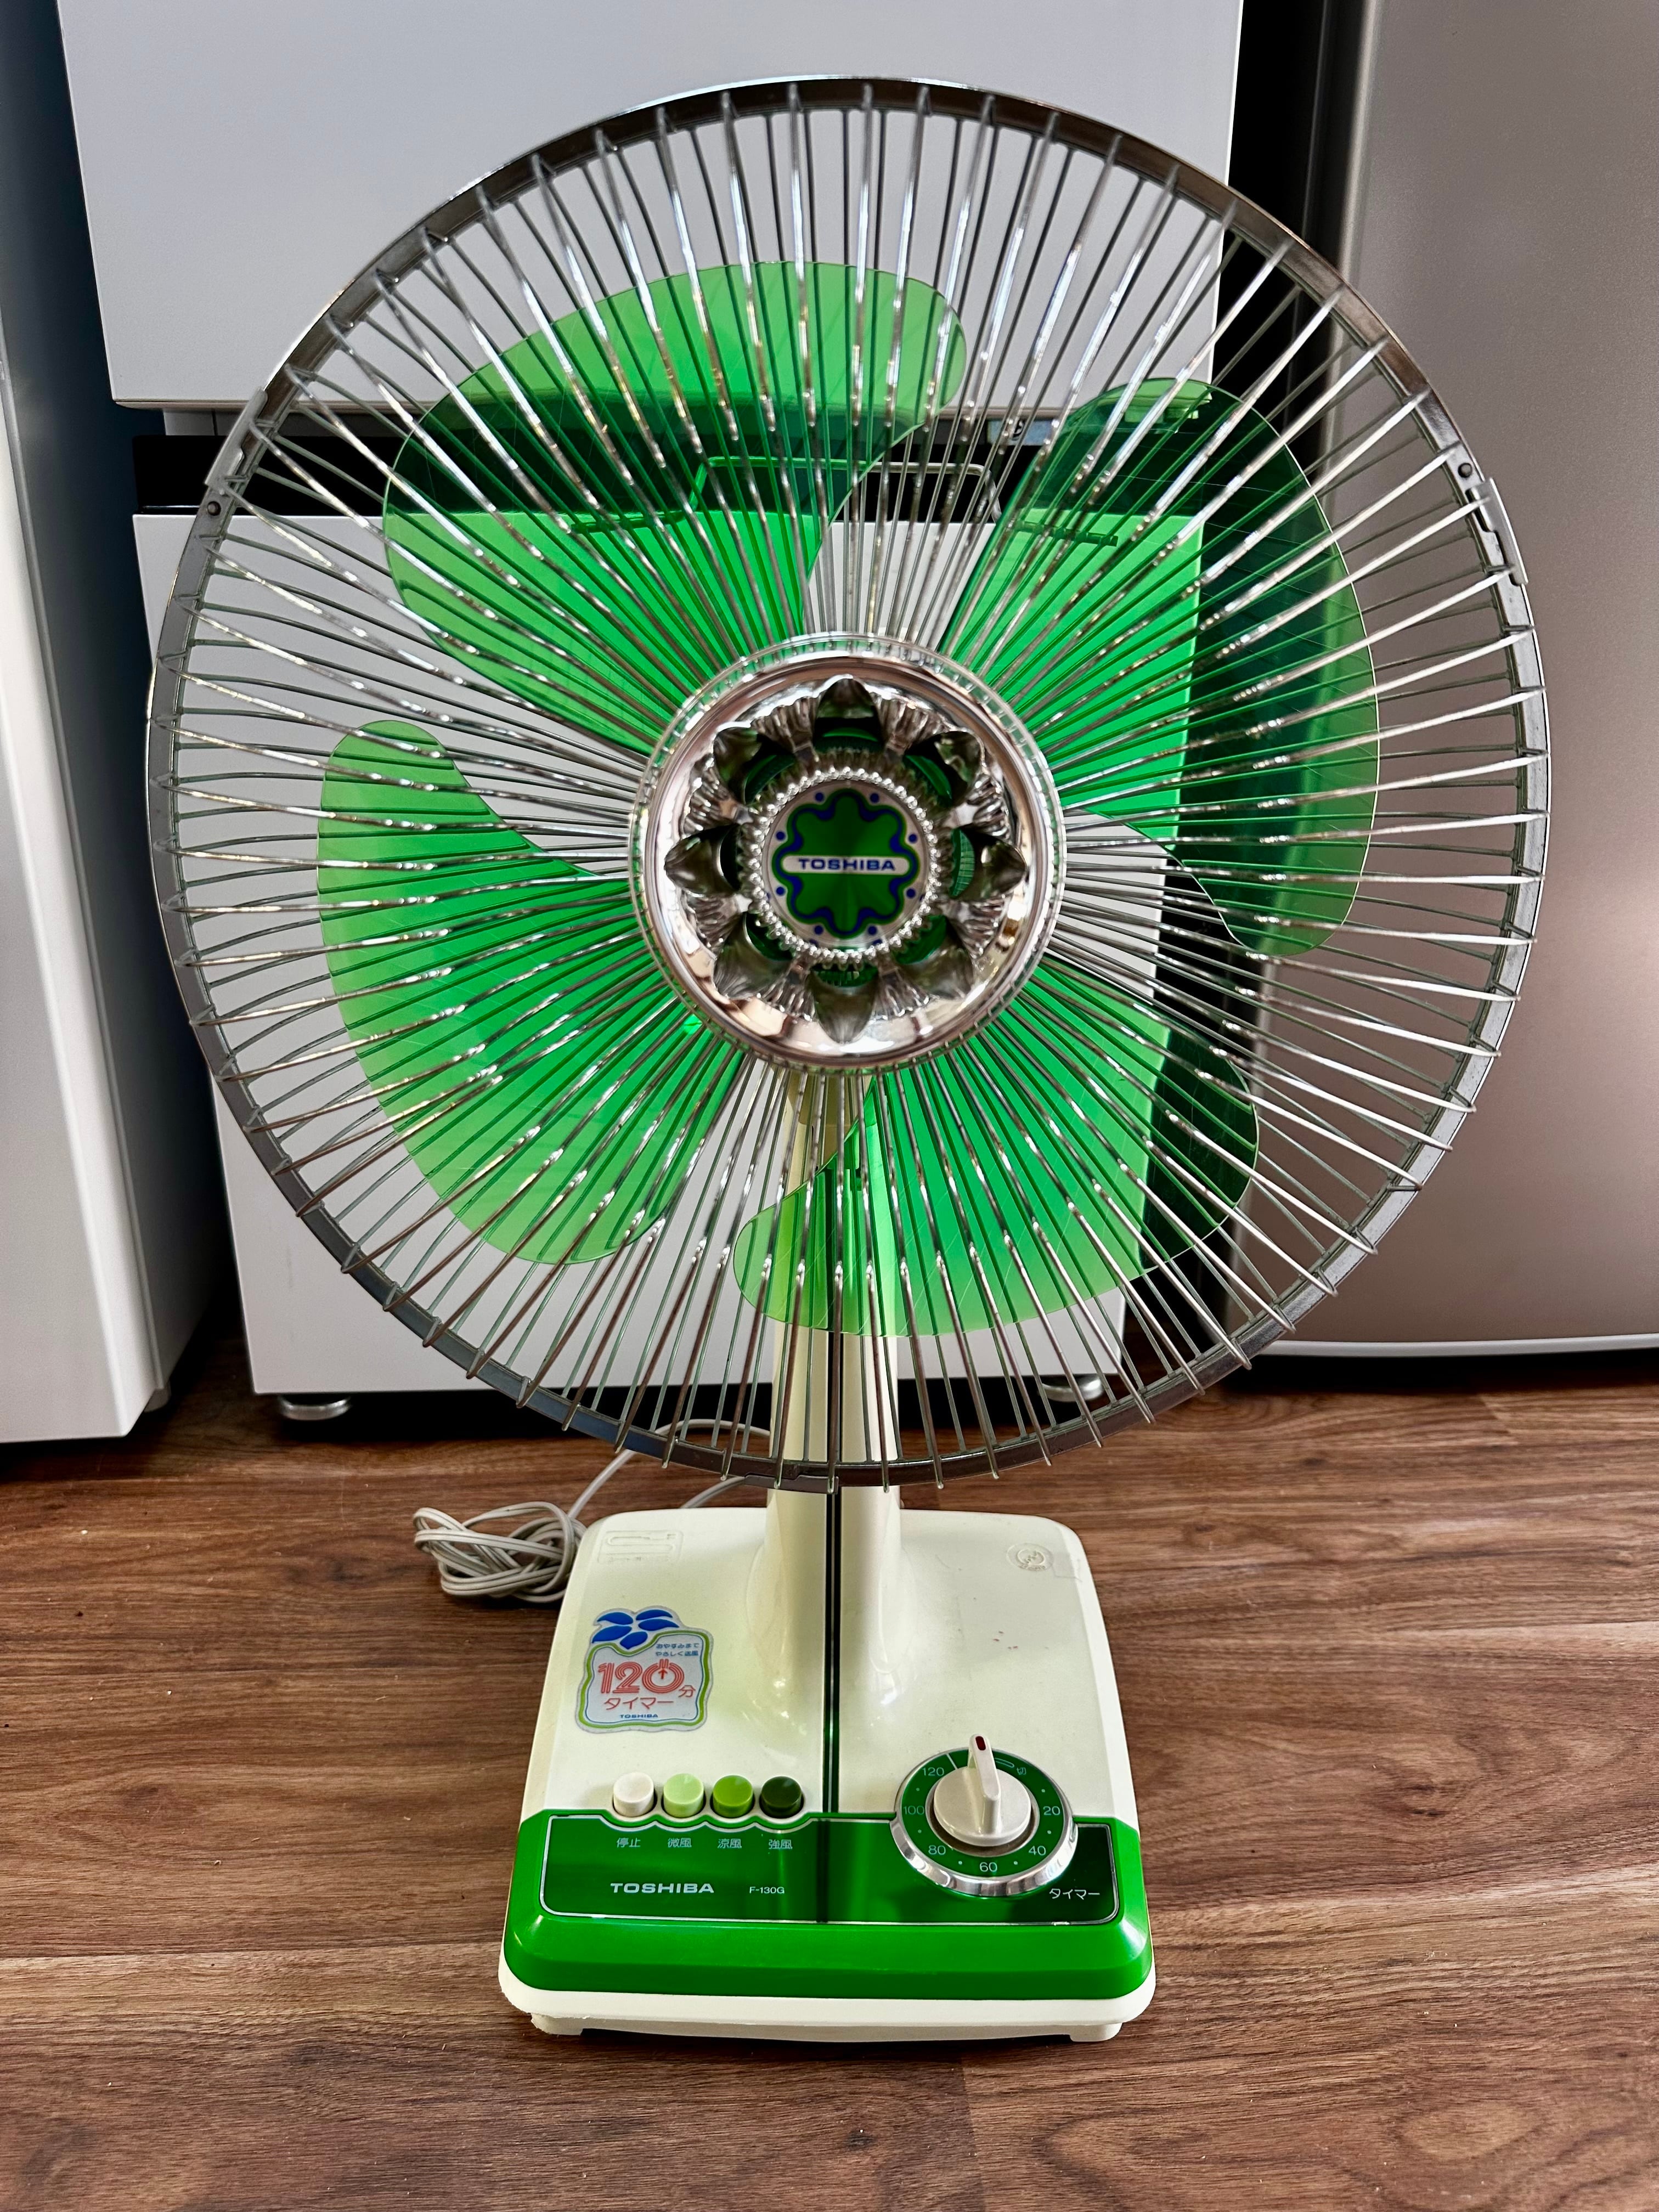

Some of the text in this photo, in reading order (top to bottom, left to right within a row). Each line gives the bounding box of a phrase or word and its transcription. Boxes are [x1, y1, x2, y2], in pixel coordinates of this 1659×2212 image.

[798, 858, 895, 871] TOSHIBA
[604, 1697, 674, 1711] タイマー
[922, 1767, 945, 1777] 120
[1017, 1767, 1027, 1776] 切
[904, 1805, 925, 1815] 100
[1043, 1805, 1060, 1815] 20
[616, 1838, 641, 1848] 停止
[667, 1837, 692, 1848] 微風
[717, 1838, 742, 1849] 涼風
[768, 1839, 793, 1850] 強風
[928, 1845, 946, 1855] 80
[1029, 1846, 1047, 1855] 40
[979, 1863, 997, 1872] 60
[610, 1882, 714, 1894] TOSHIBA
[749, 1886, 785, 1894] F-130G
[1049, 1888, 1101, 1900] タイマー
